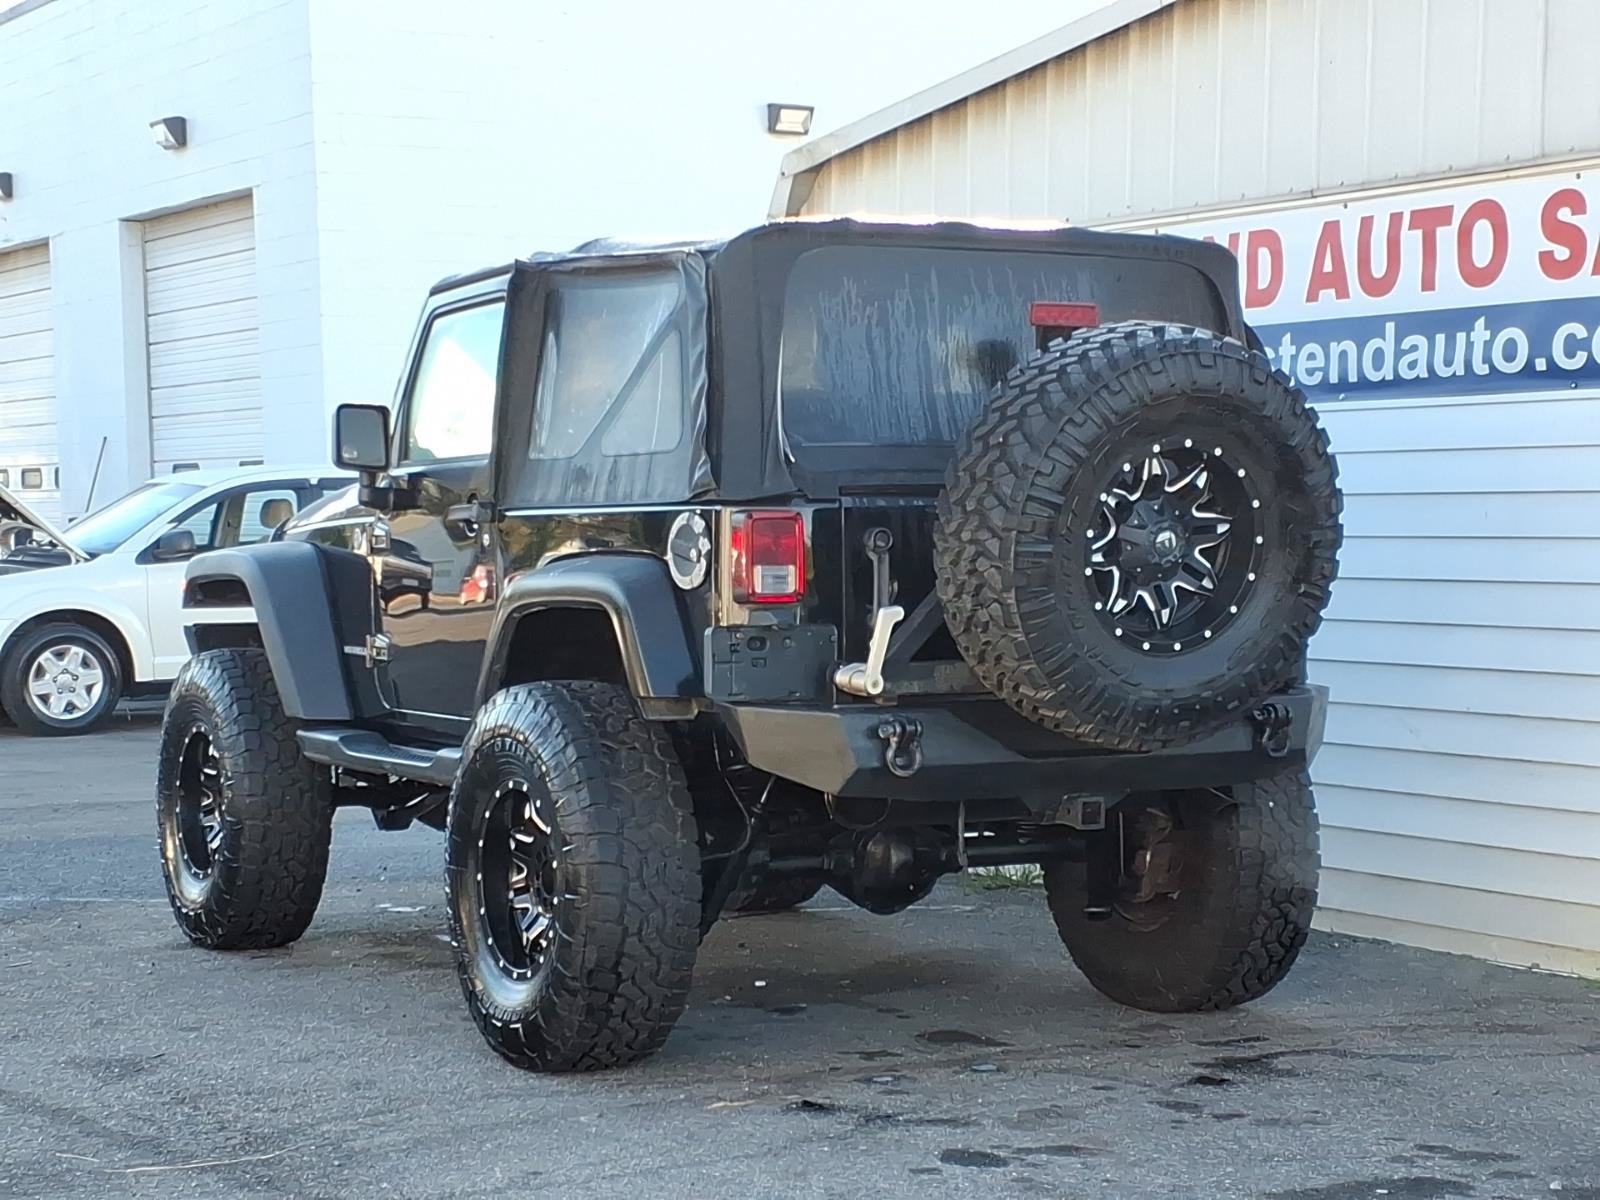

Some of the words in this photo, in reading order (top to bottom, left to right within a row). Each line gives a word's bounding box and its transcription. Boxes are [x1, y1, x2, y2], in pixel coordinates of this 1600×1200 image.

[1305, 198, 1509, 304] AUTO
[1538, 188, 1600, 281] S
[1264, 316, 1600, 387] tendauto.c
